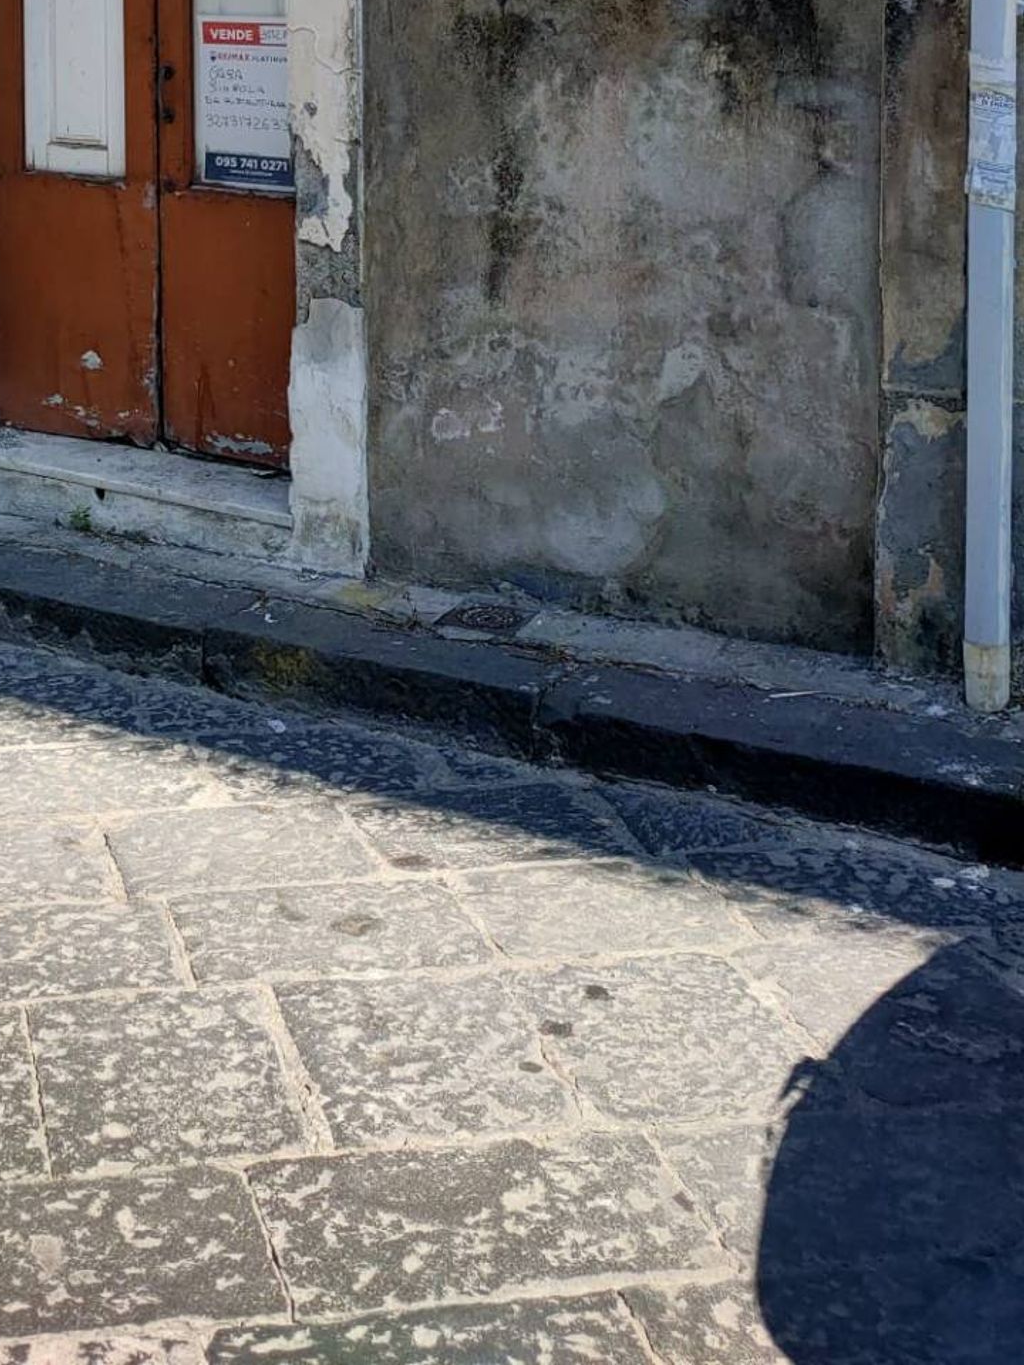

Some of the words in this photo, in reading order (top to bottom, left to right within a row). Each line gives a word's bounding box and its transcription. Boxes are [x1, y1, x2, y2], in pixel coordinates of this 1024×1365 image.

[210, 28, 254, 41] VENDE
[215, 156, 237, 167] 095
[240, 158, 258, 169] 741
[261, 159, 288, 171] 0271
